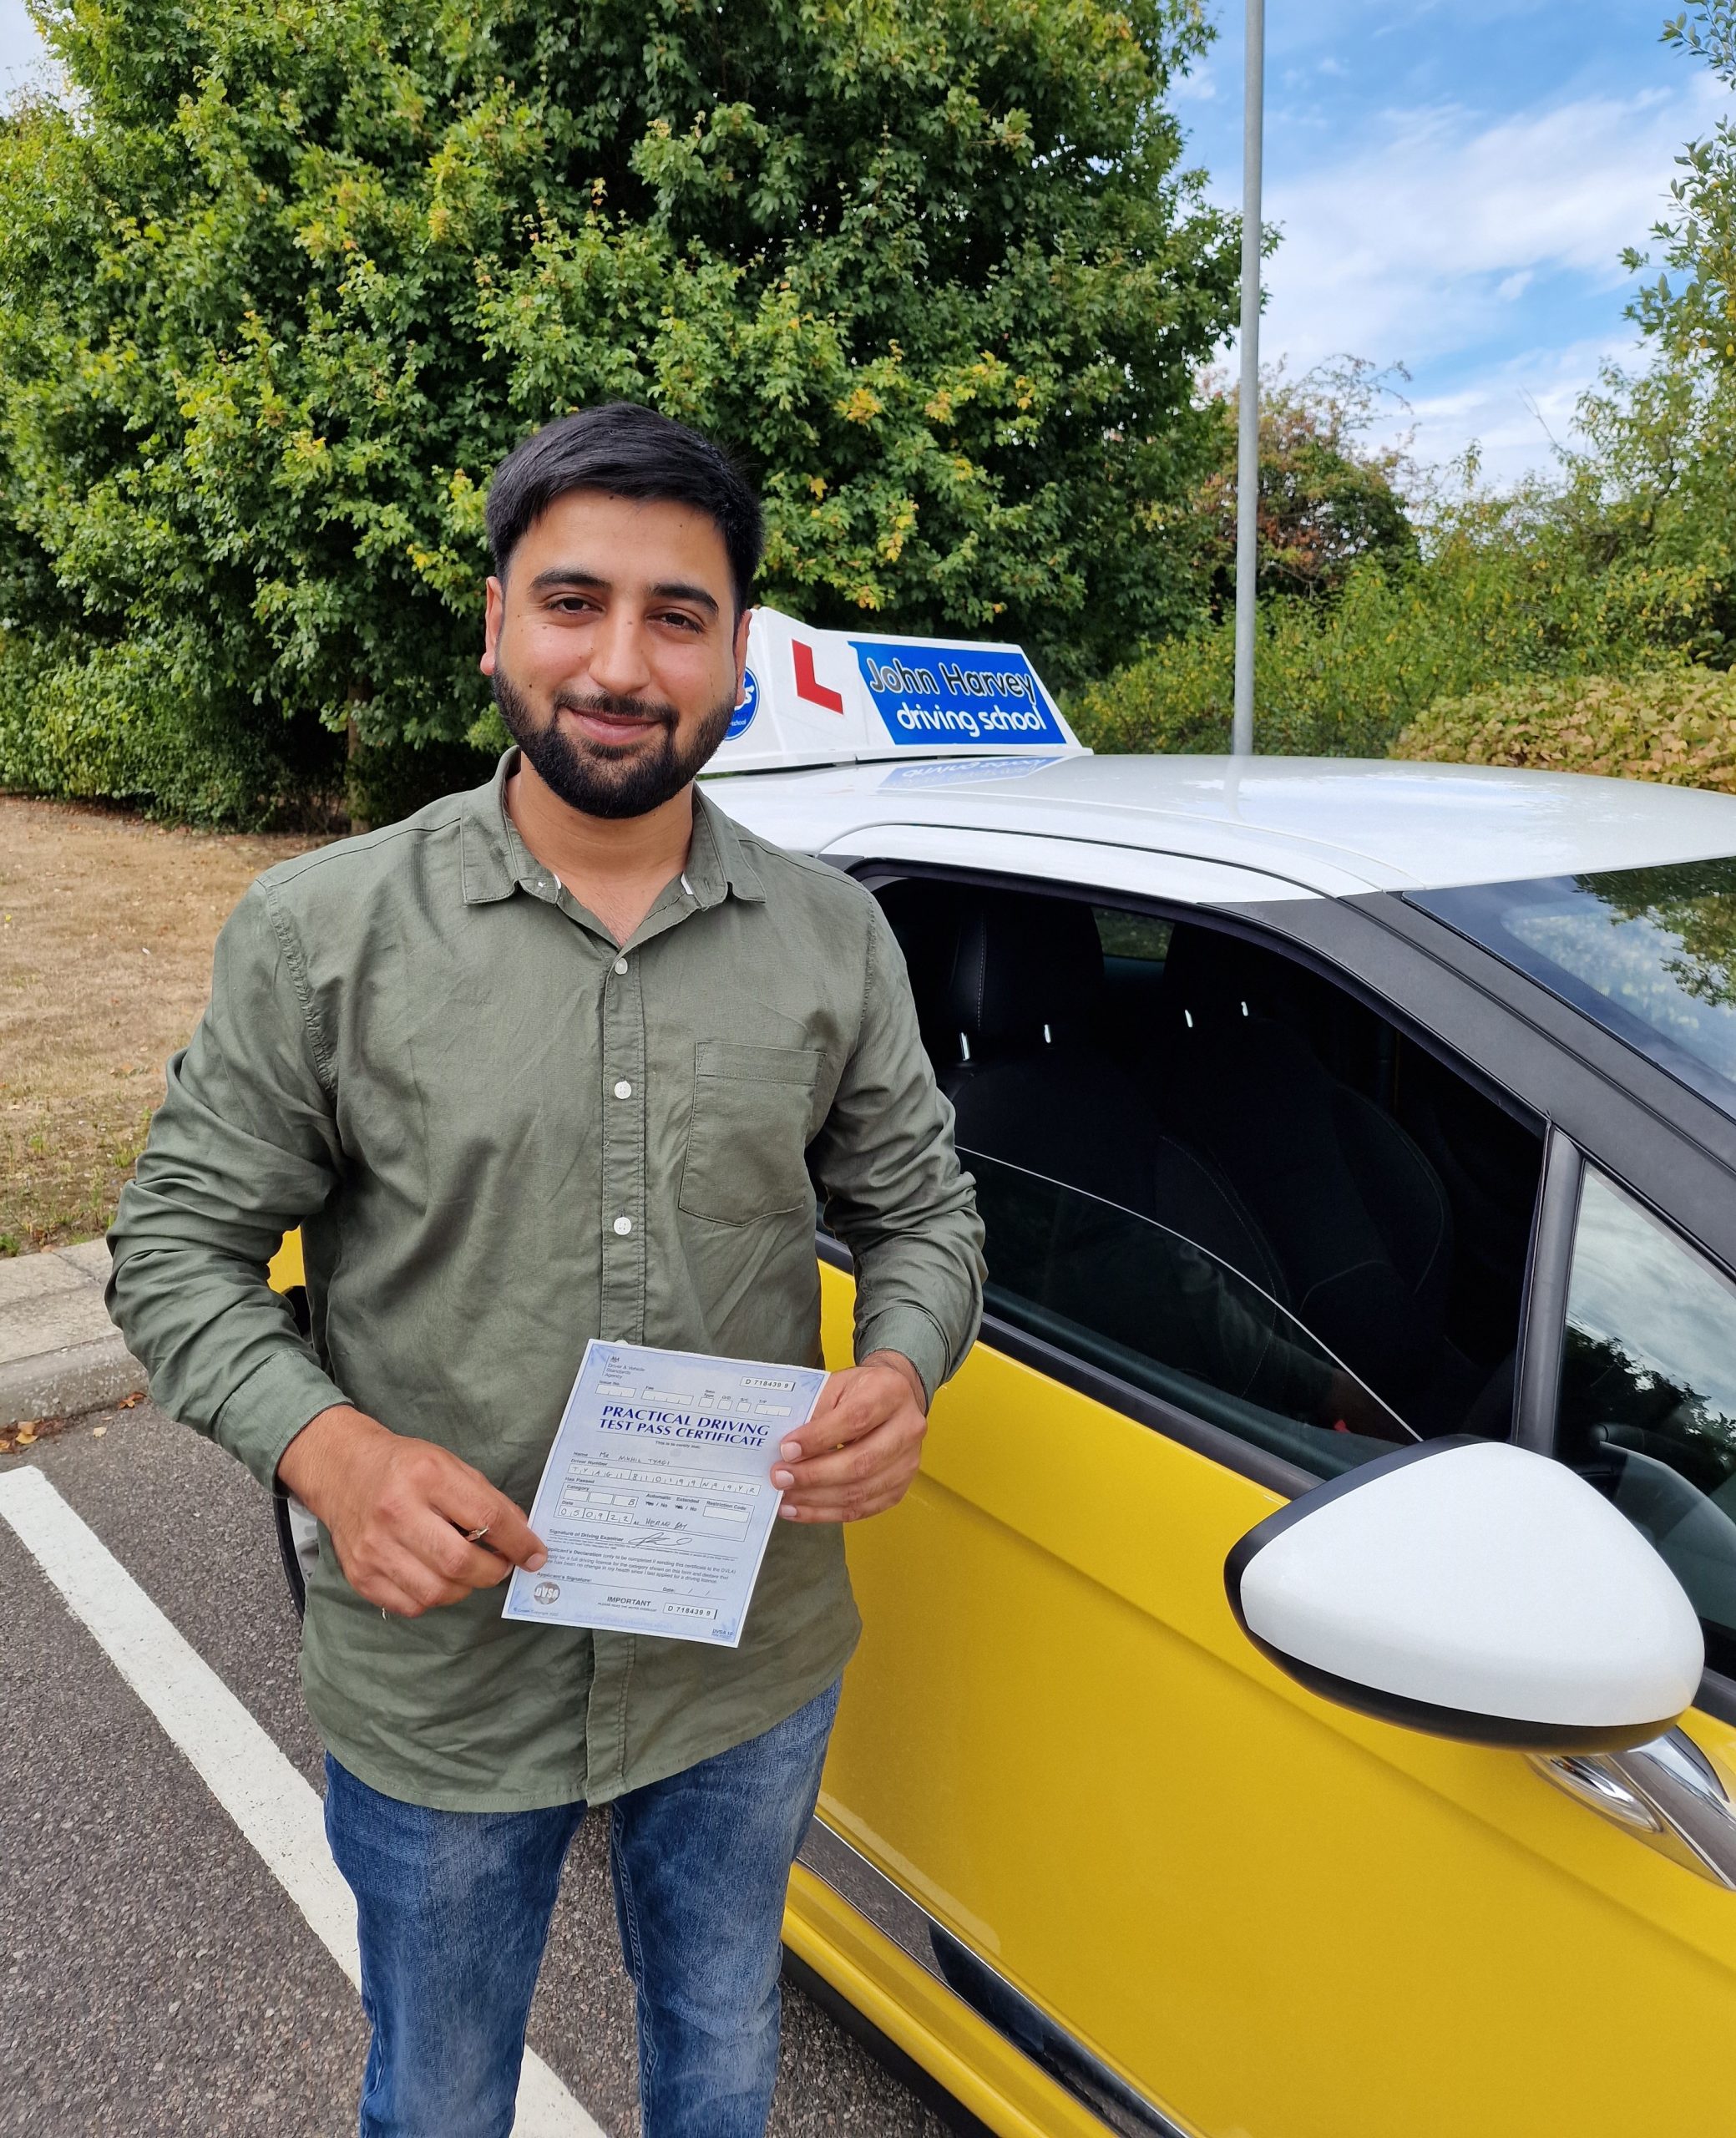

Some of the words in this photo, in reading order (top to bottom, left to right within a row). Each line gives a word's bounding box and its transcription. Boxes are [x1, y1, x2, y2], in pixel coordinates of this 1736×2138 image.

[792, 638, 843, 714] L
[866, 657, 939, 694] John
[939, 662, 1036, 706] Harvey
[897, 702, 980, 737] driving
[978, 705, 1047, 731] school
[754, 1380, 782, 1388] 718439
[600, 1418, 634, 1431] TEST
[637, 1422, 672, 1435] PASS
[676, 1427, 767, 1446] CERTIFICATE
[603, 1406, 691, 1426] PRACTICAL
[697, 1417, 771, 1436] DRIVING
[607, 1596, 651, 1606] IMPORTANT
[676, 1607, 704, 1615] 718439
